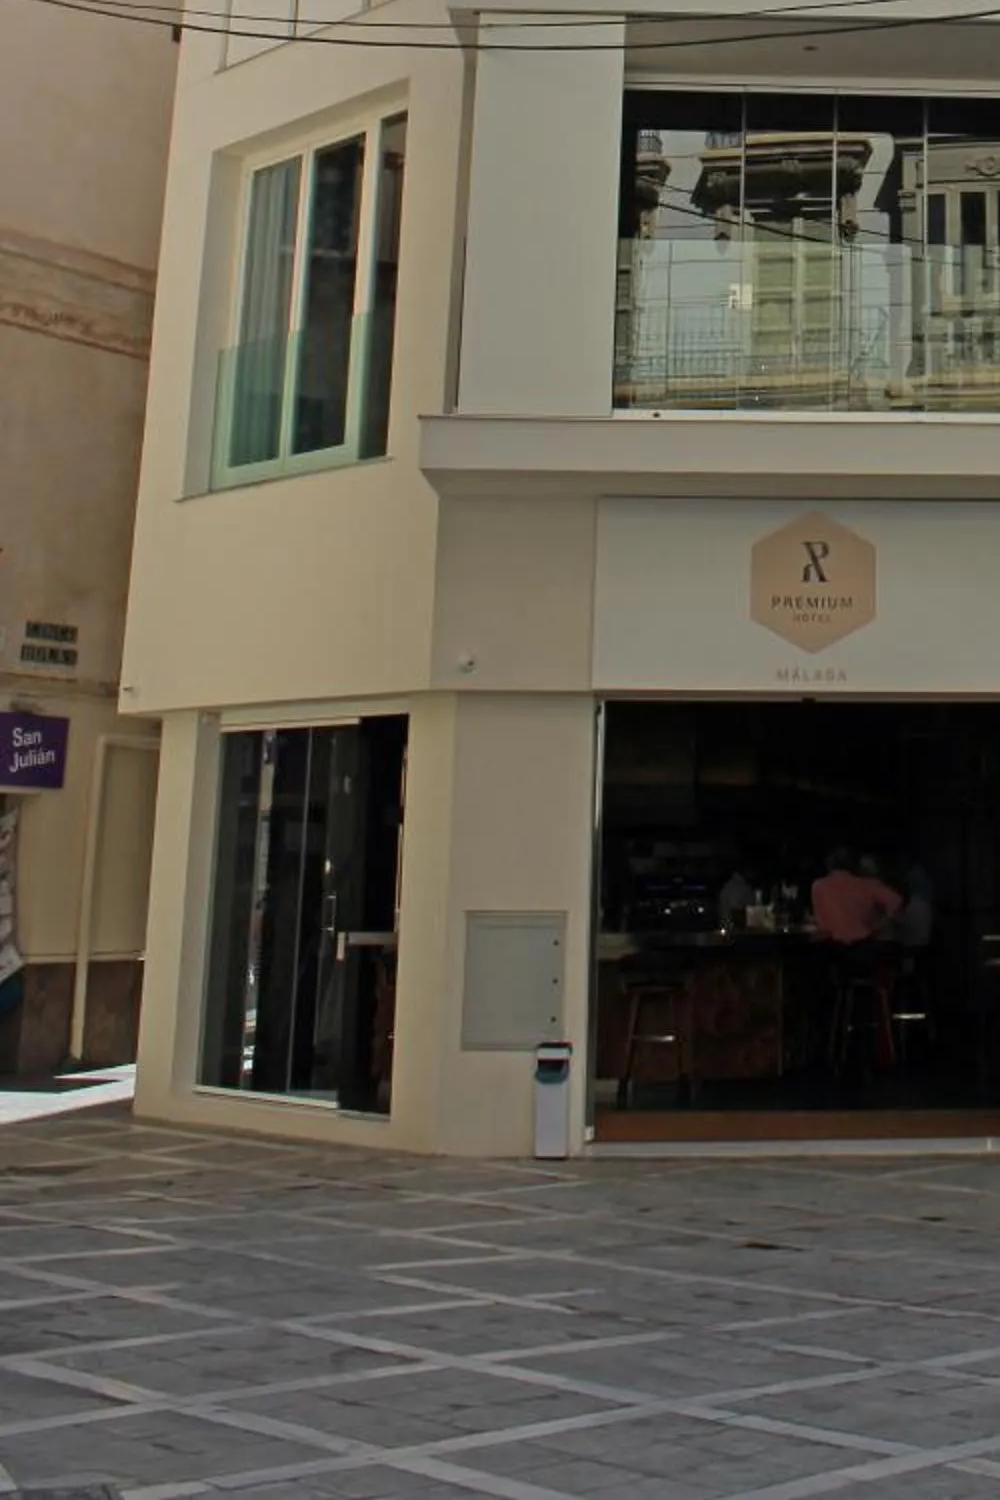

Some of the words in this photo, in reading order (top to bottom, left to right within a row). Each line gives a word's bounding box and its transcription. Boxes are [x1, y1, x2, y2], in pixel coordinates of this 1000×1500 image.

[771, 595, 853, 610] PREMIUM
[12, 726, 43, 748] San
[9, 748, 55, 773] Julián
